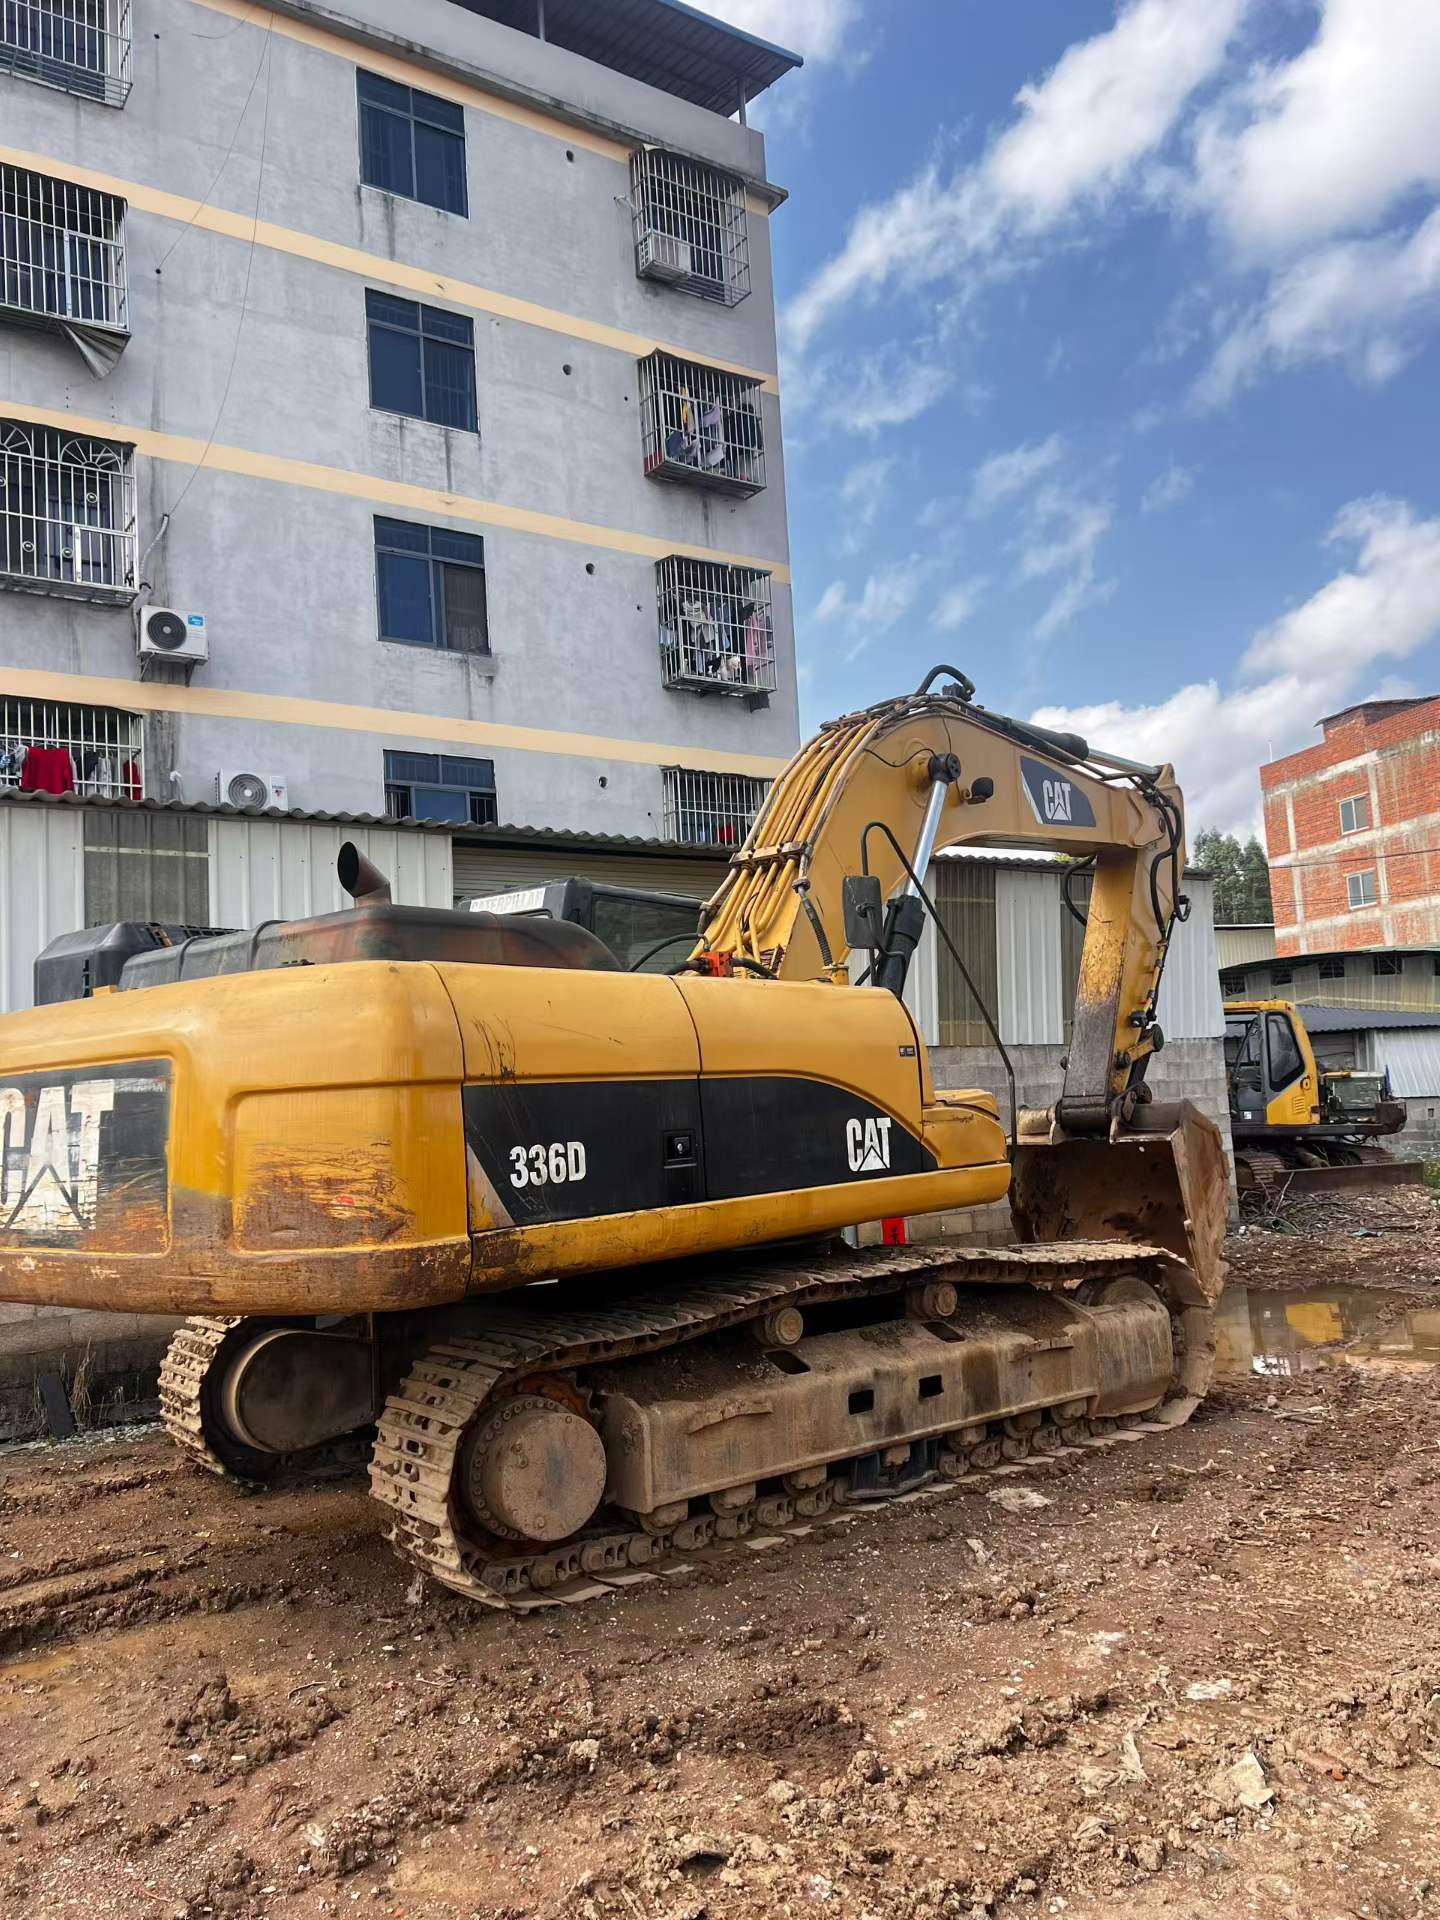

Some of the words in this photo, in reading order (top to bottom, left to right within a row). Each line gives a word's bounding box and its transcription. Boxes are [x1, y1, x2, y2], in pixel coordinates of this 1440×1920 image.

[1042, 780, 1072, 821] CAT
[0, 1079, 114, 1230] CAT
[509, 1141, 587, 1189] 336D
[846, 1117, 892, 1172] CAT
